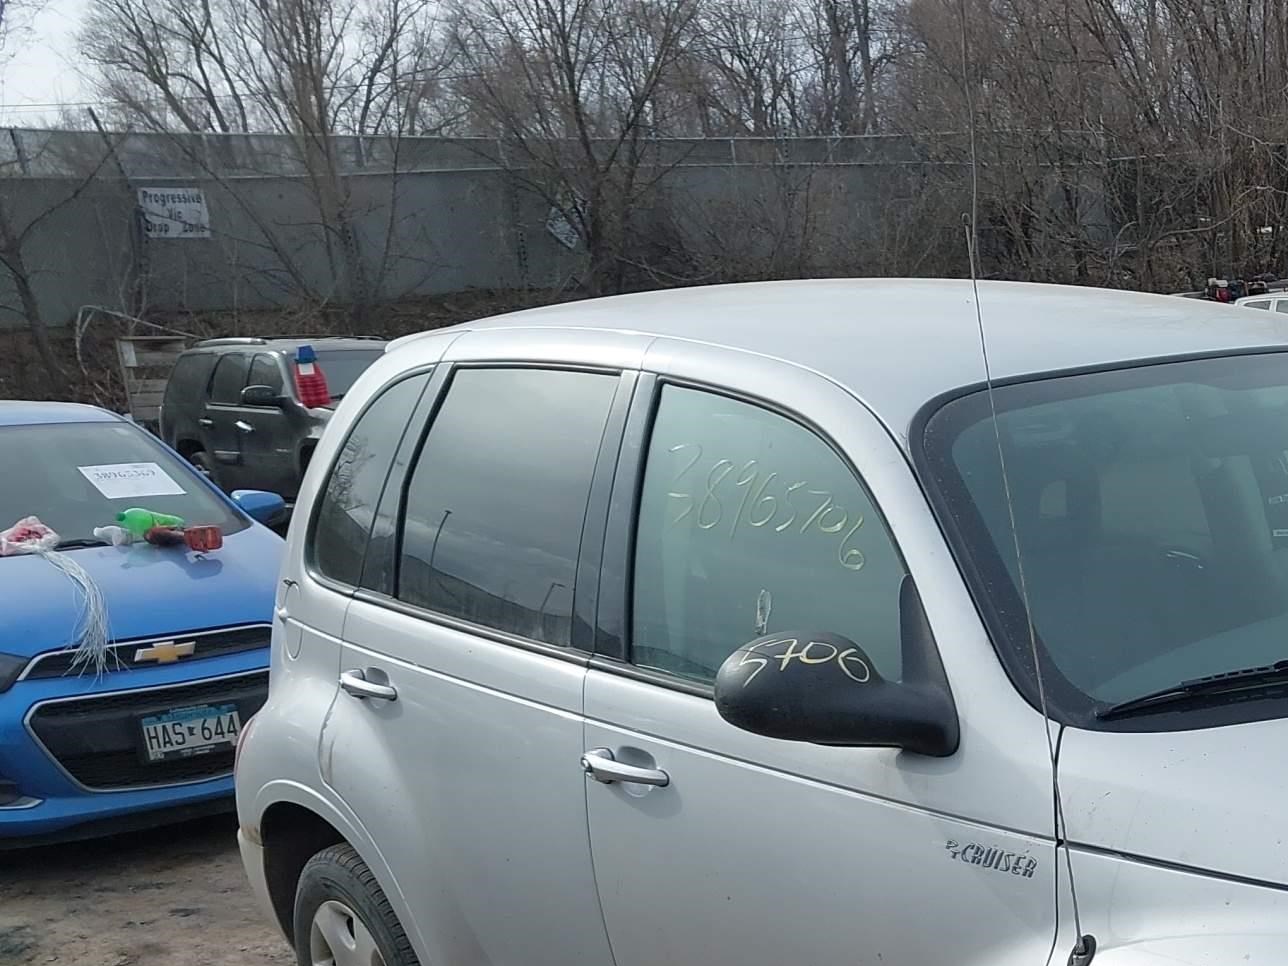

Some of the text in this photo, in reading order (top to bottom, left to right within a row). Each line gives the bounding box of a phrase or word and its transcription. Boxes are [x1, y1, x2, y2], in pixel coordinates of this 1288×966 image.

[739, 638, 871, 687] 5706
[146, 714, 238, 750] HAS 644
[961, 842, 1038, 878] CRUISER
